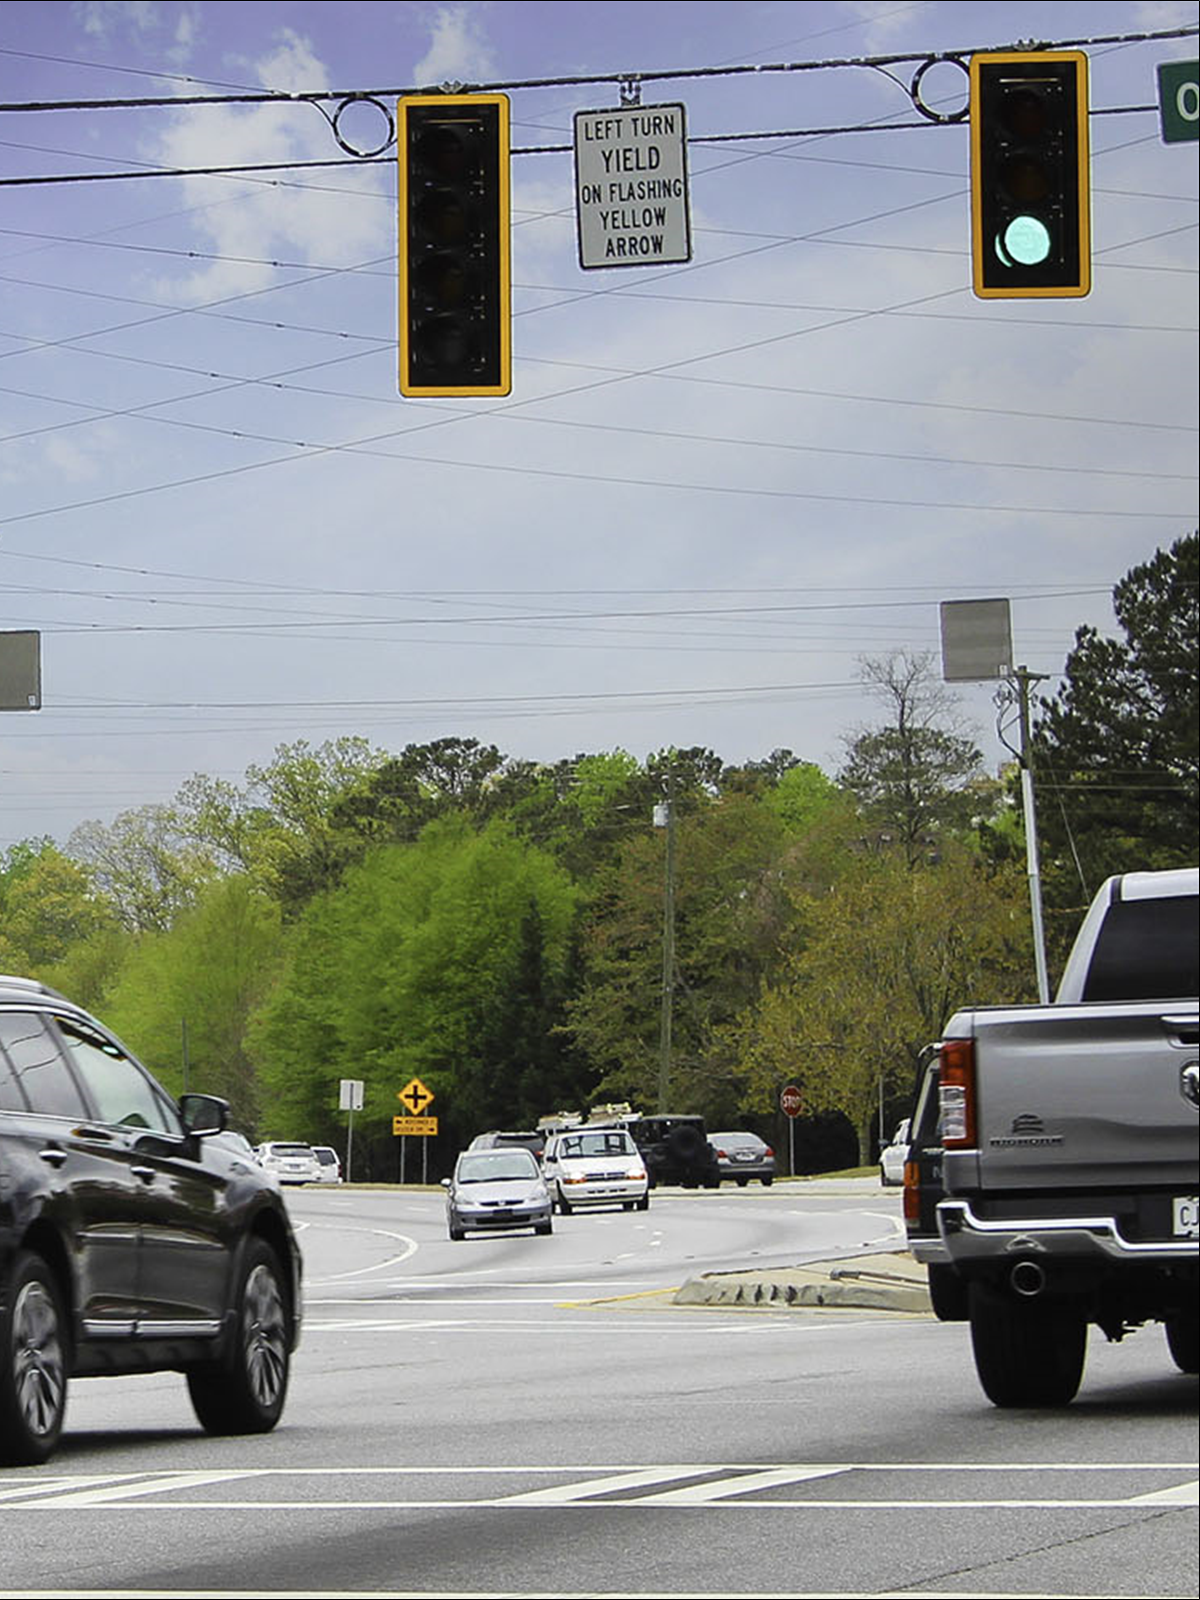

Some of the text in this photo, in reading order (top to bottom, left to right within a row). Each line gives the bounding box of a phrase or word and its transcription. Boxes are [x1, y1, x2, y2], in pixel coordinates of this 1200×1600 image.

[584, 114, 675, 141] LEFT TURN
[601, 146, 660, 173] YIELD
[581, 178, 682, 205] ON FLASHING
[600, 206, 666, 231] YELLOW
[605, 234, 663, 257] ARROW
